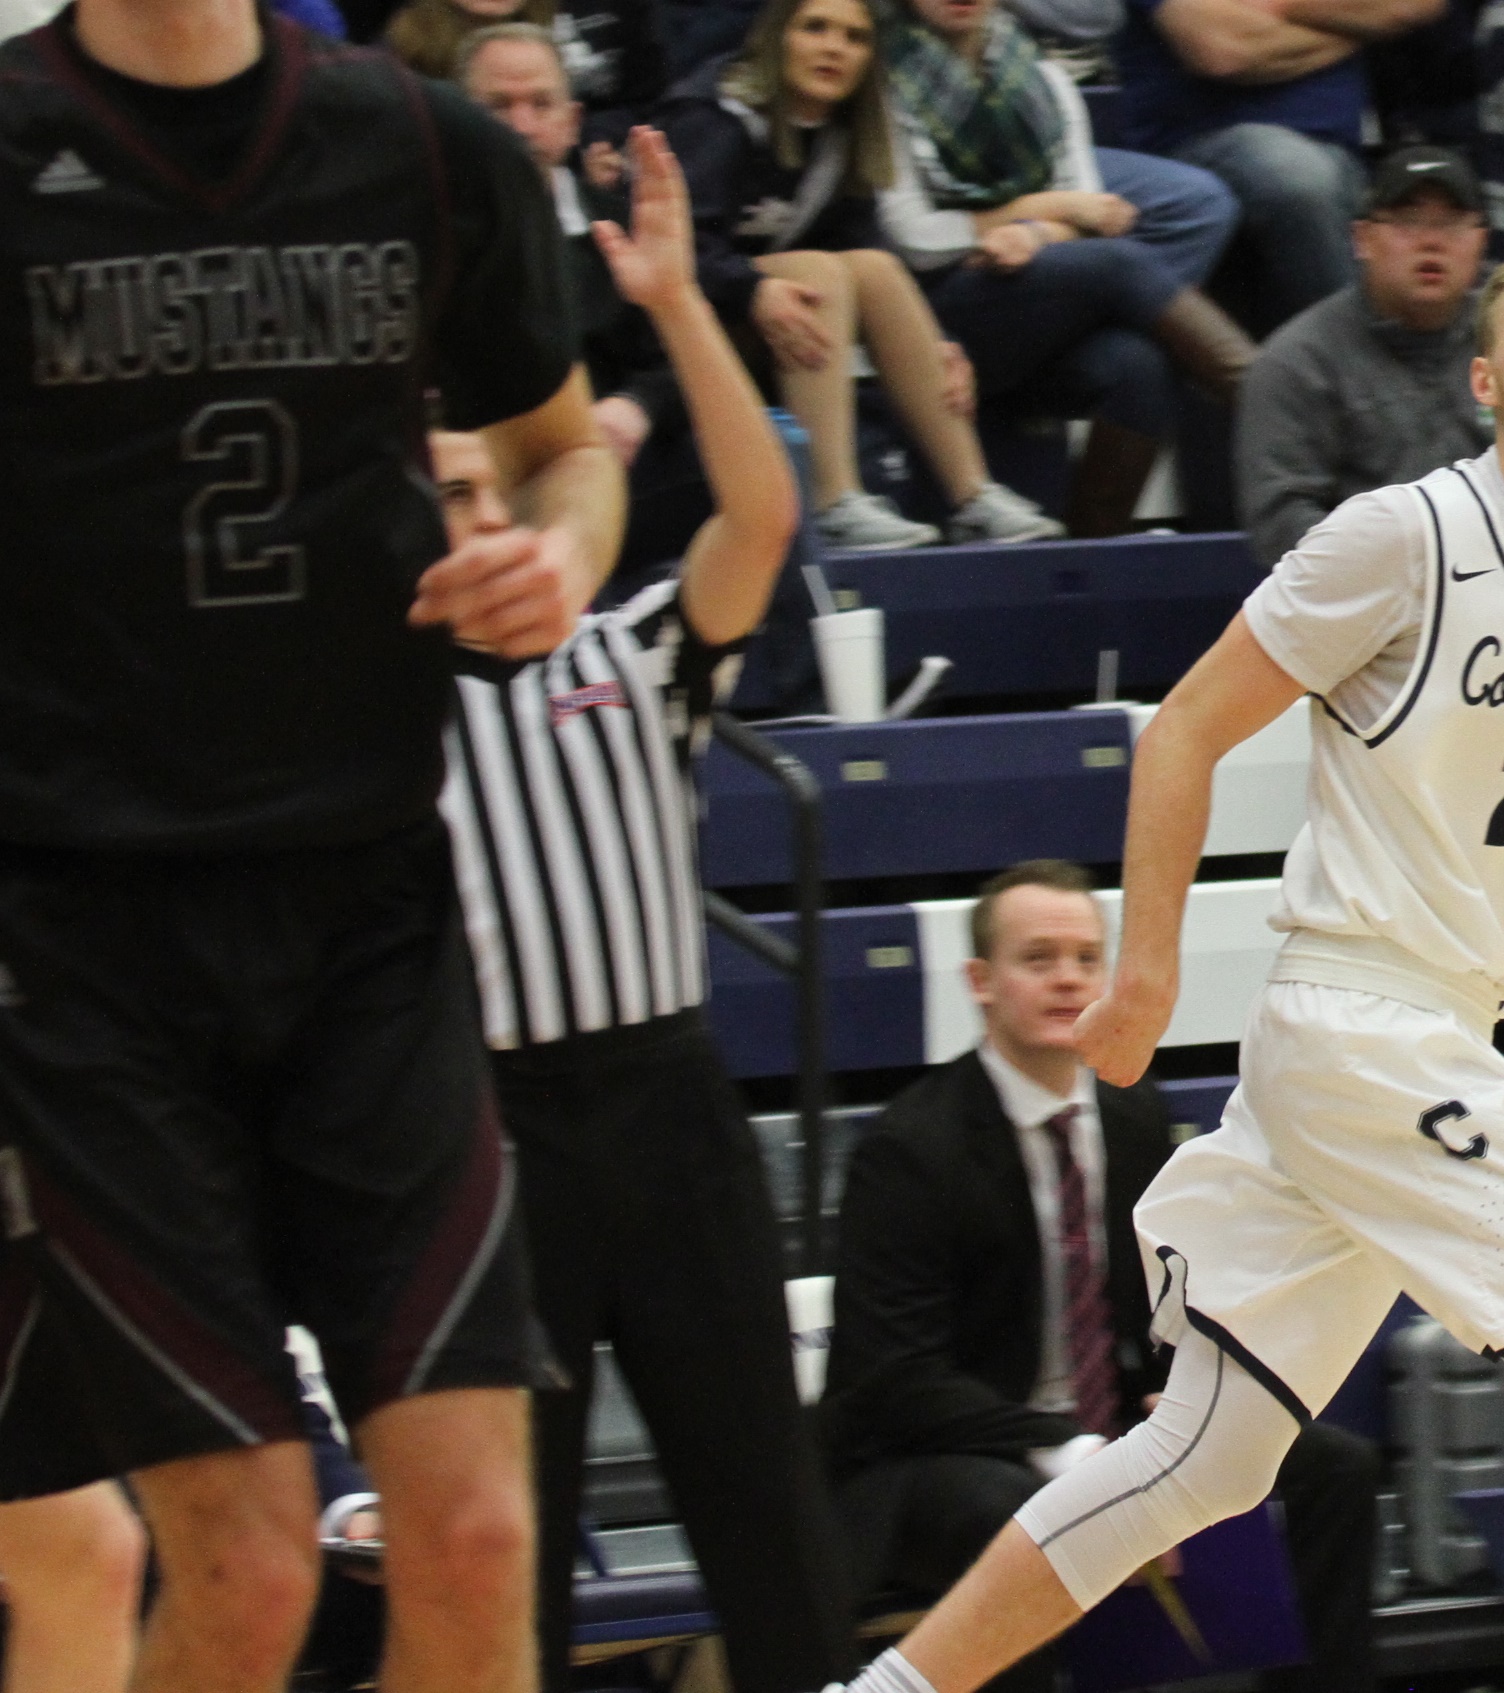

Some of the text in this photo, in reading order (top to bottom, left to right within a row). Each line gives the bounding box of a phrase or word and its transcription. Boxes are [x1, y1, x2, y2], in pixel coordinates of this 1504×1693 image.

[25, 239, 419, 386] MUSTANGS
[181, 398, 306, 608] 2
[1416, 1099, 1490, 1161] C
